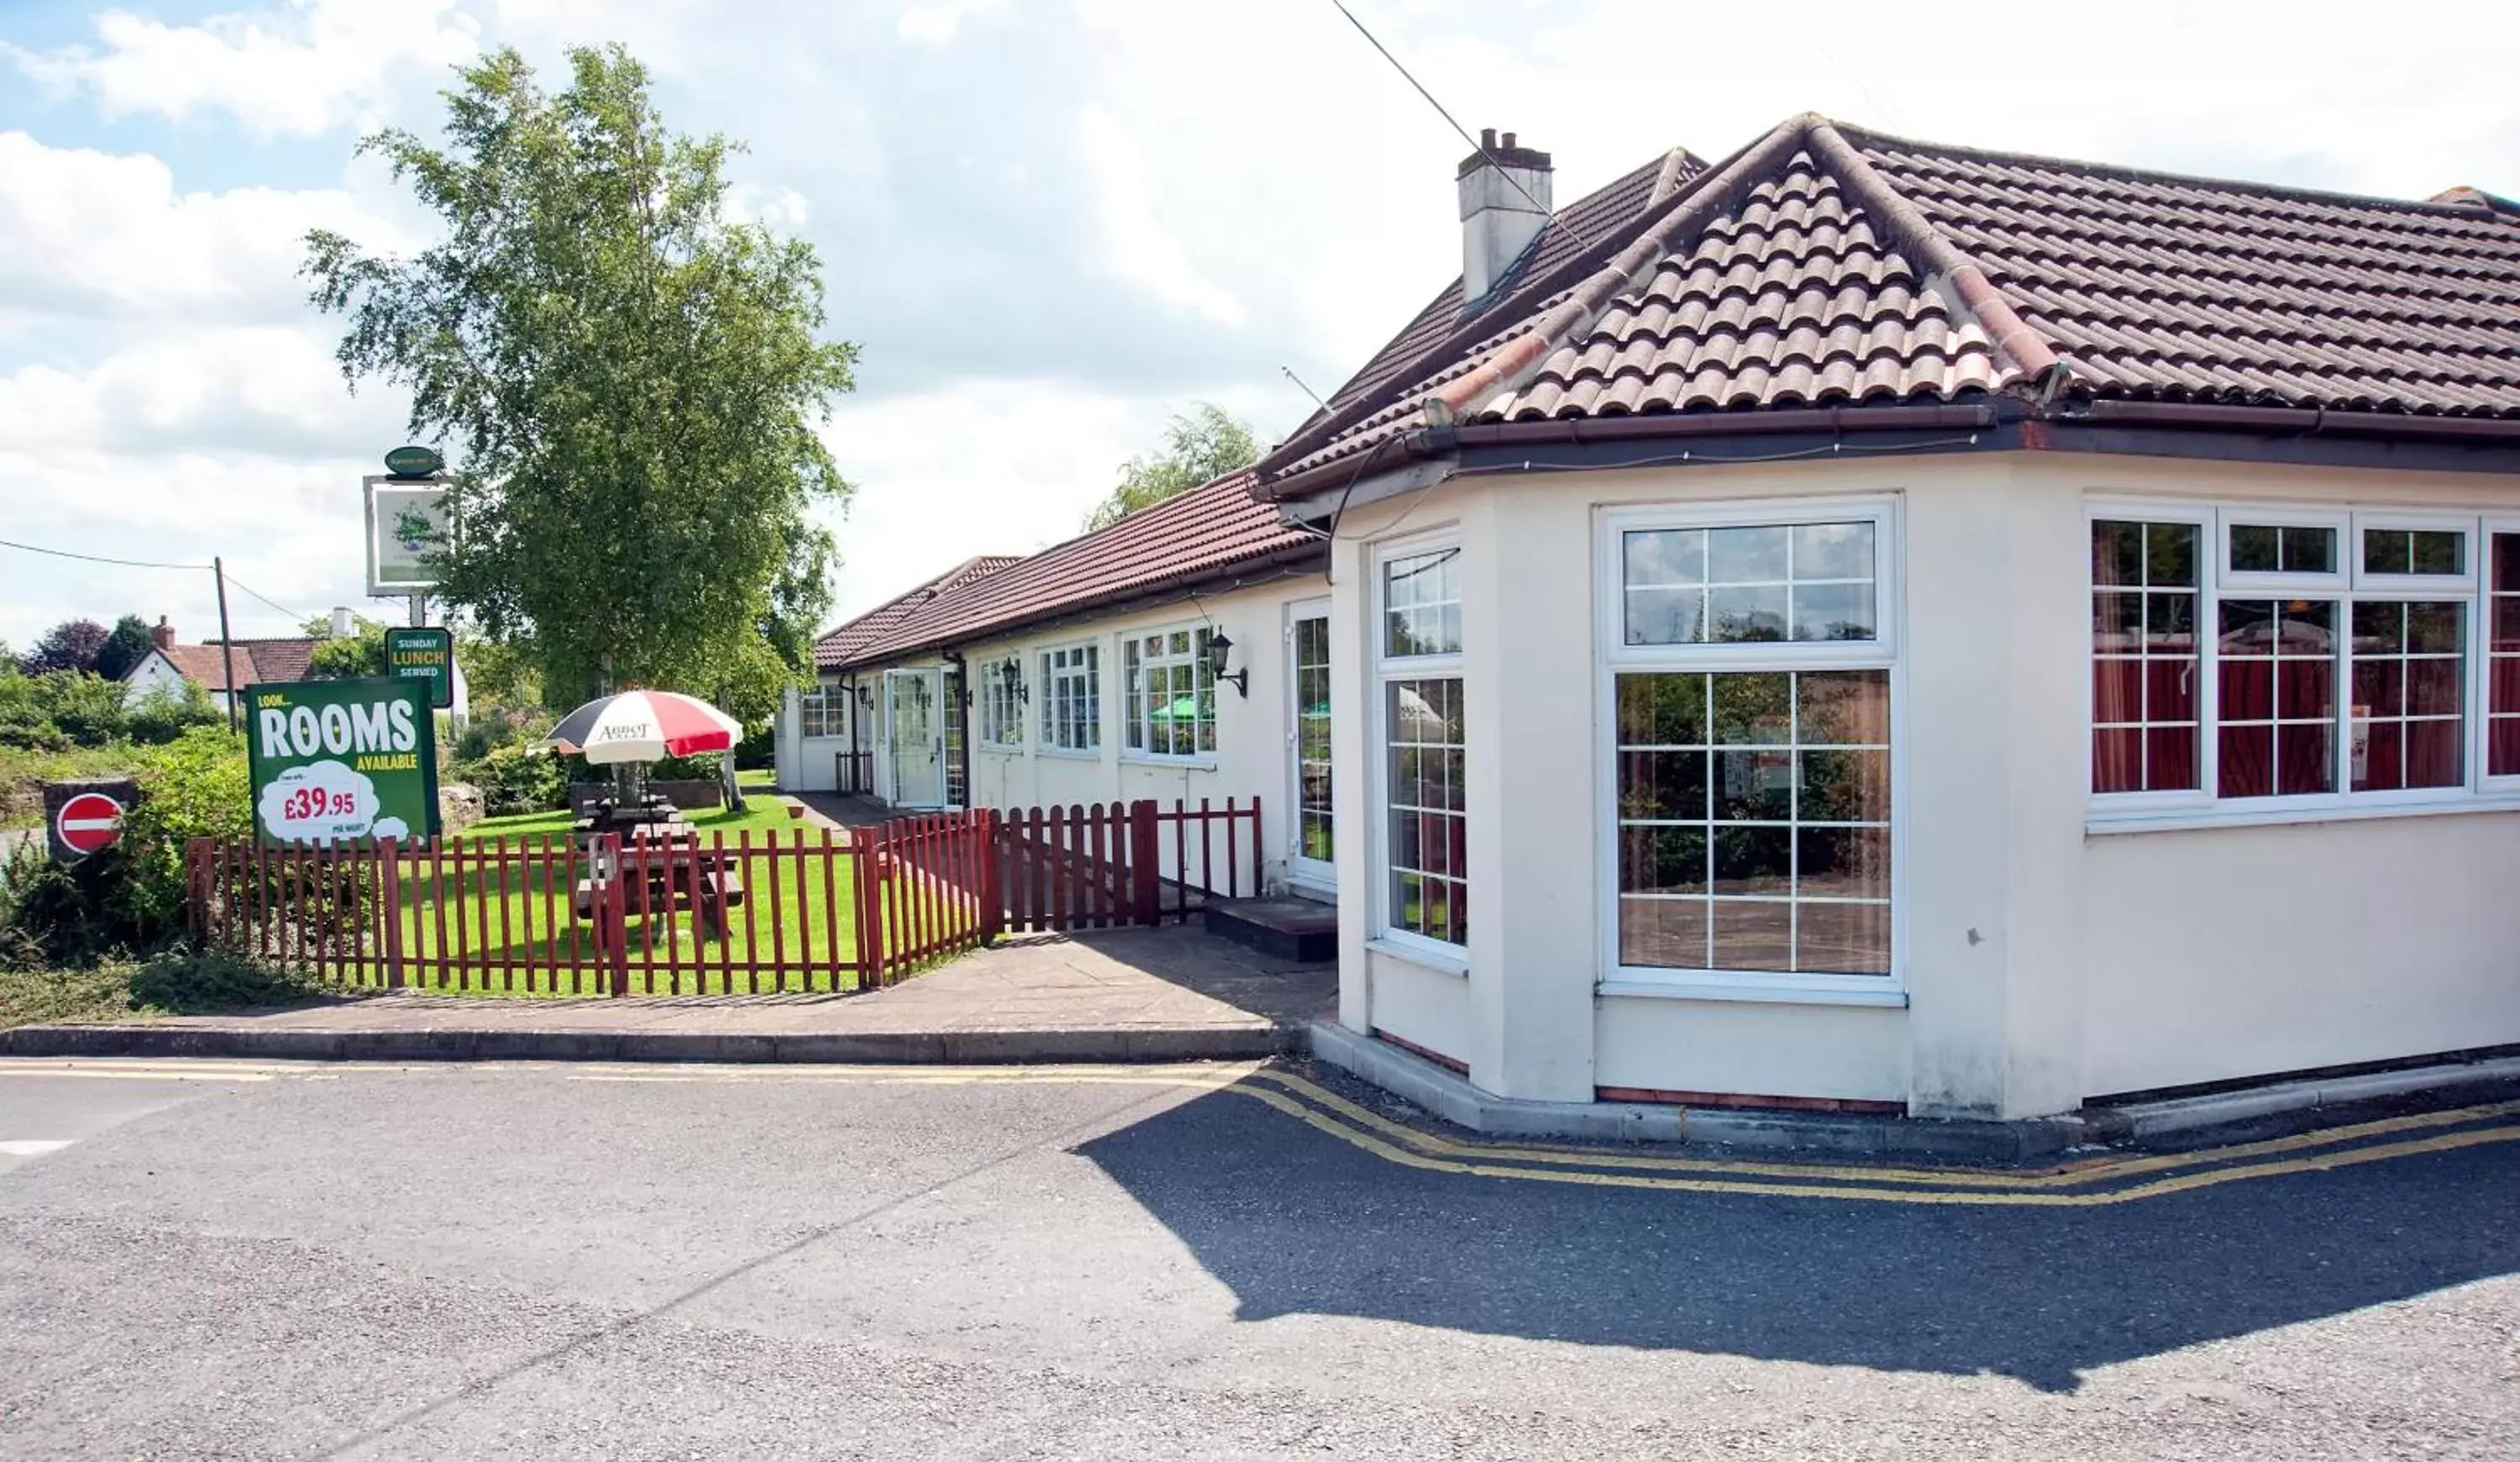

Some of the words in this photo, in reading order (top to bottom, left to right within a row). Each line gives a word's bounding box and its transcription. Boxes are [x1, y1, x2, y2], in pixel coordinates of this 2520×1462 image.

[397, 639, 438, 649] SUNDAY
[392, 651, 444, 665] LUNCH
[259, 698, 417, 758] ROOMS
[356, 754, 417, 770] AVAILABLE
[285, 786, 354, 820] £39.95
